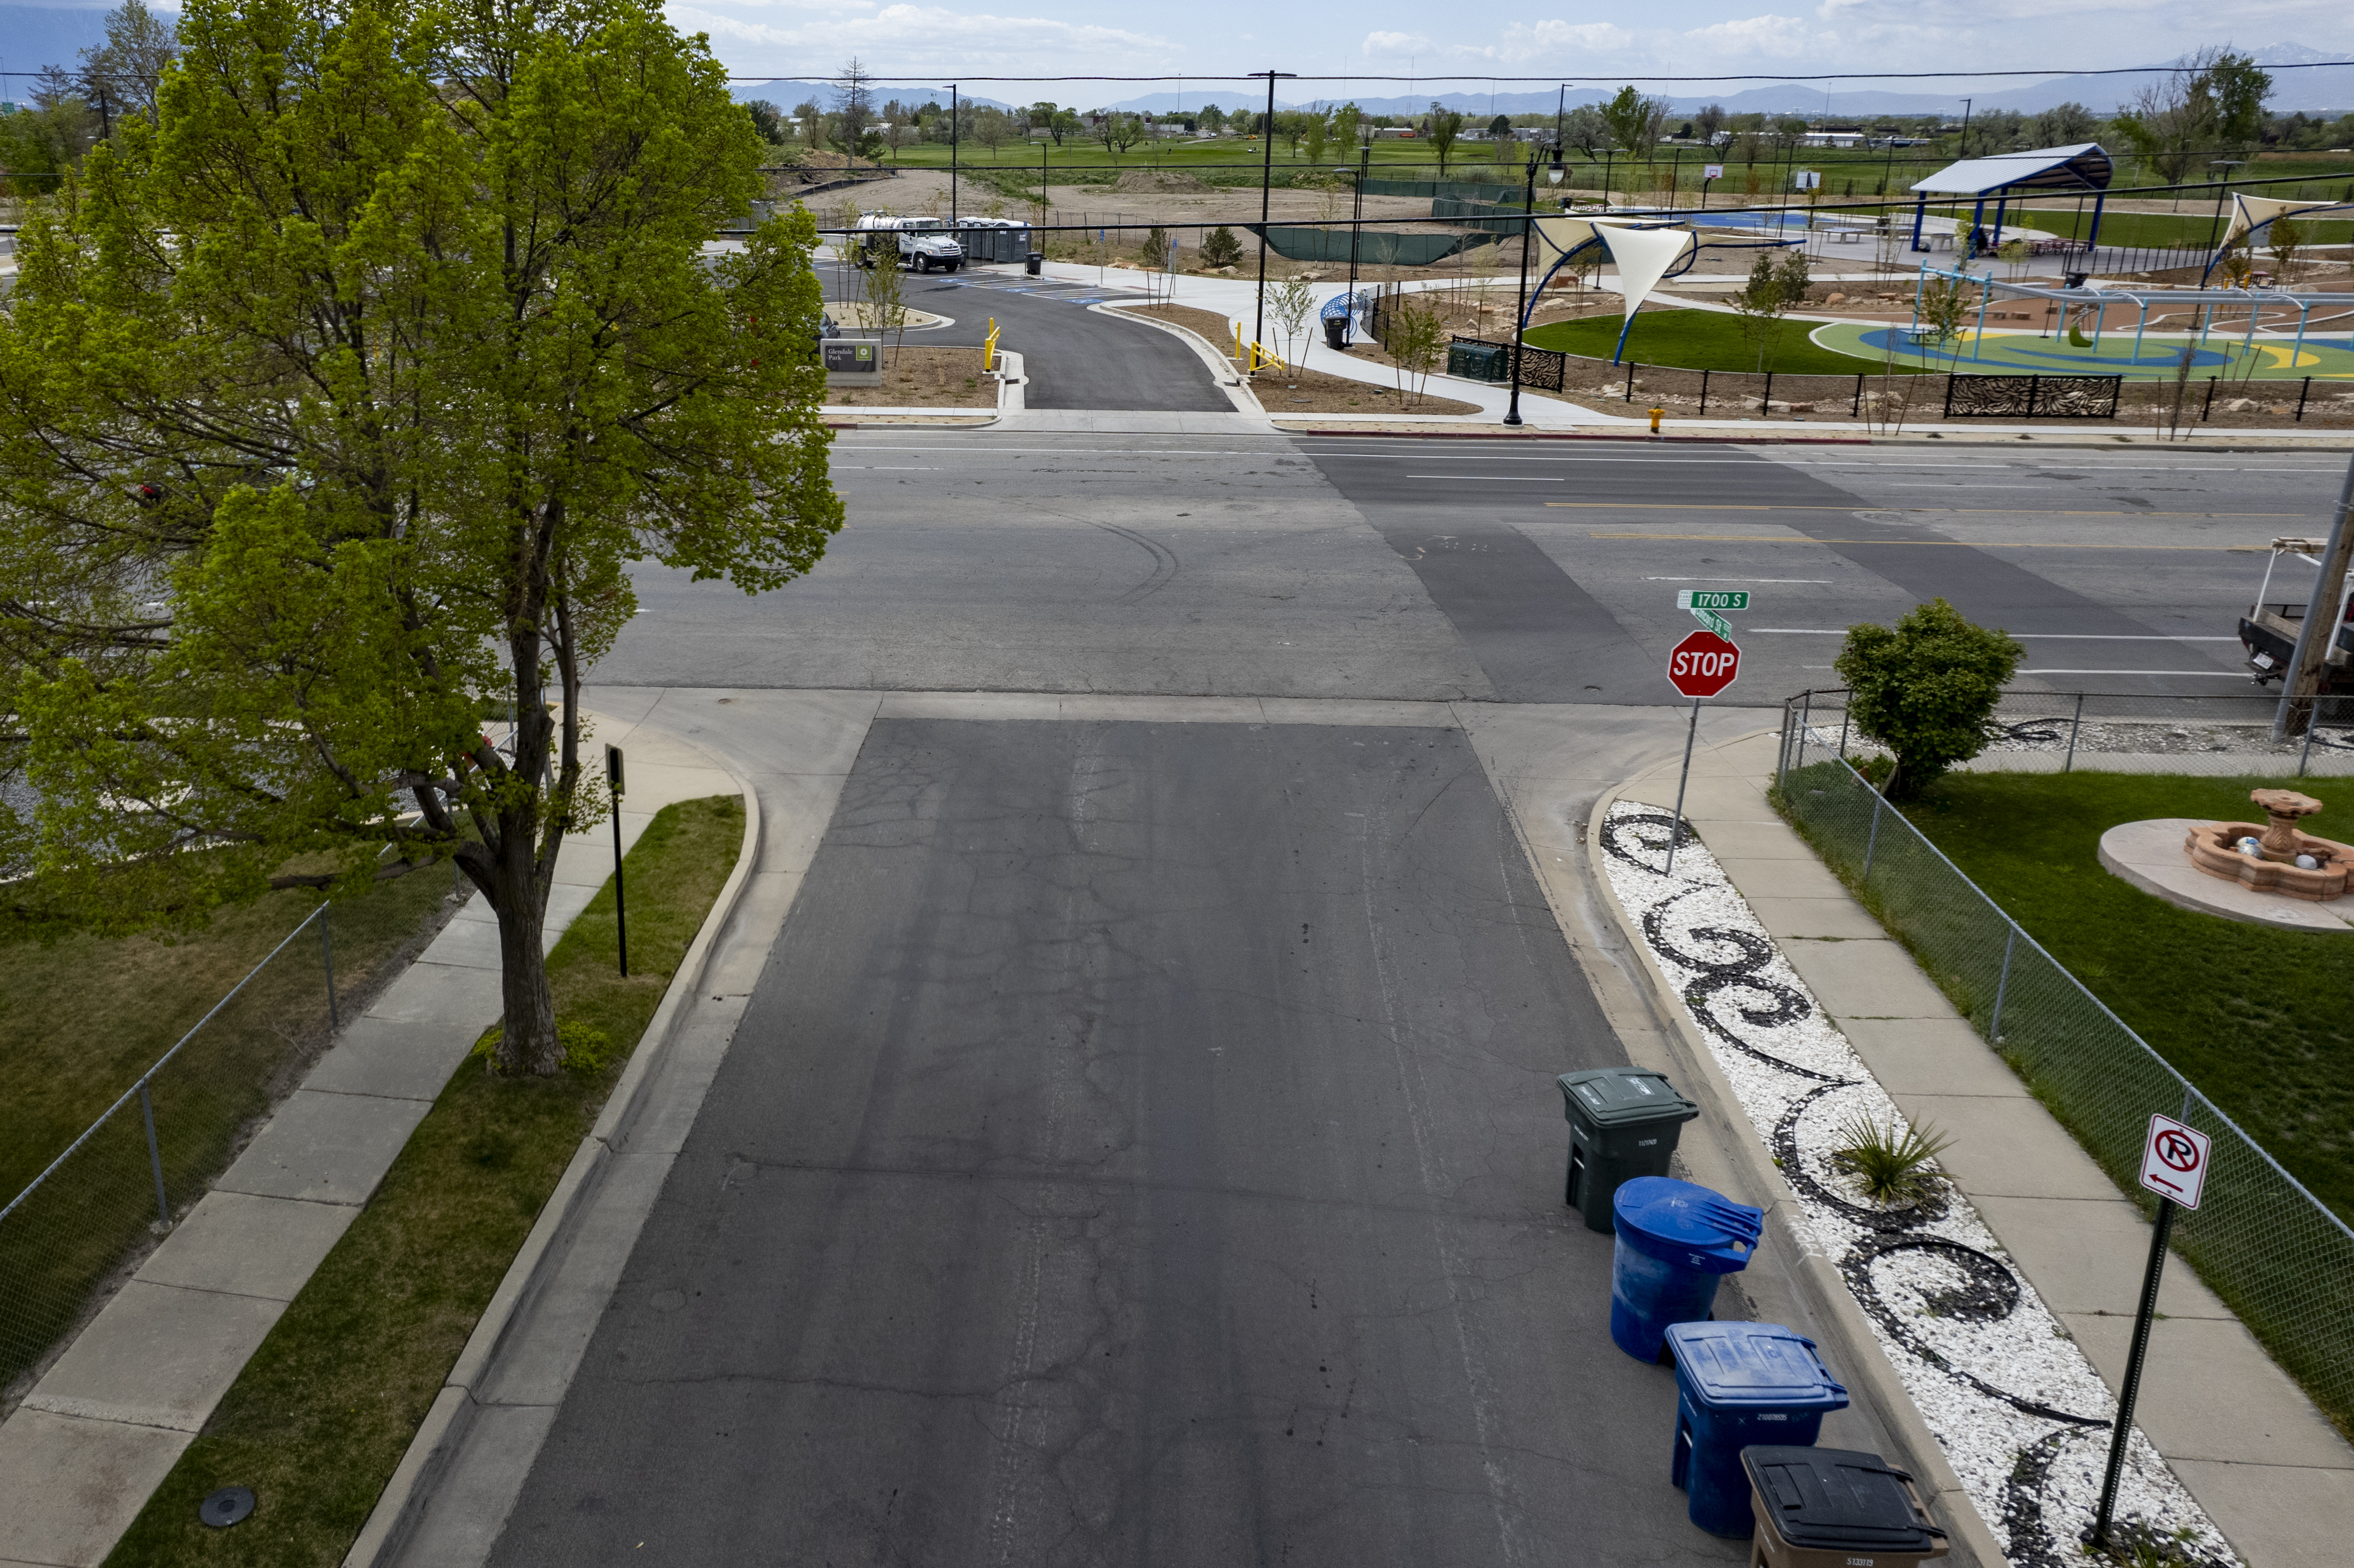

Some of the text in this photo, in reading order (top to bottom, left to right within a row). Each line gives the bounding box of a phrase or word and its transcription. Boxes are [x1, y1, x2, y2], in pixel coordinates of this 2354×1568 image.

[1698, 594, 1742, 606] 1700 S
[1714, 619, 1722, 634] St
[1673, 651, 1735, 676] STOP
[1847, 1558, 1874, 1566] 5133119
